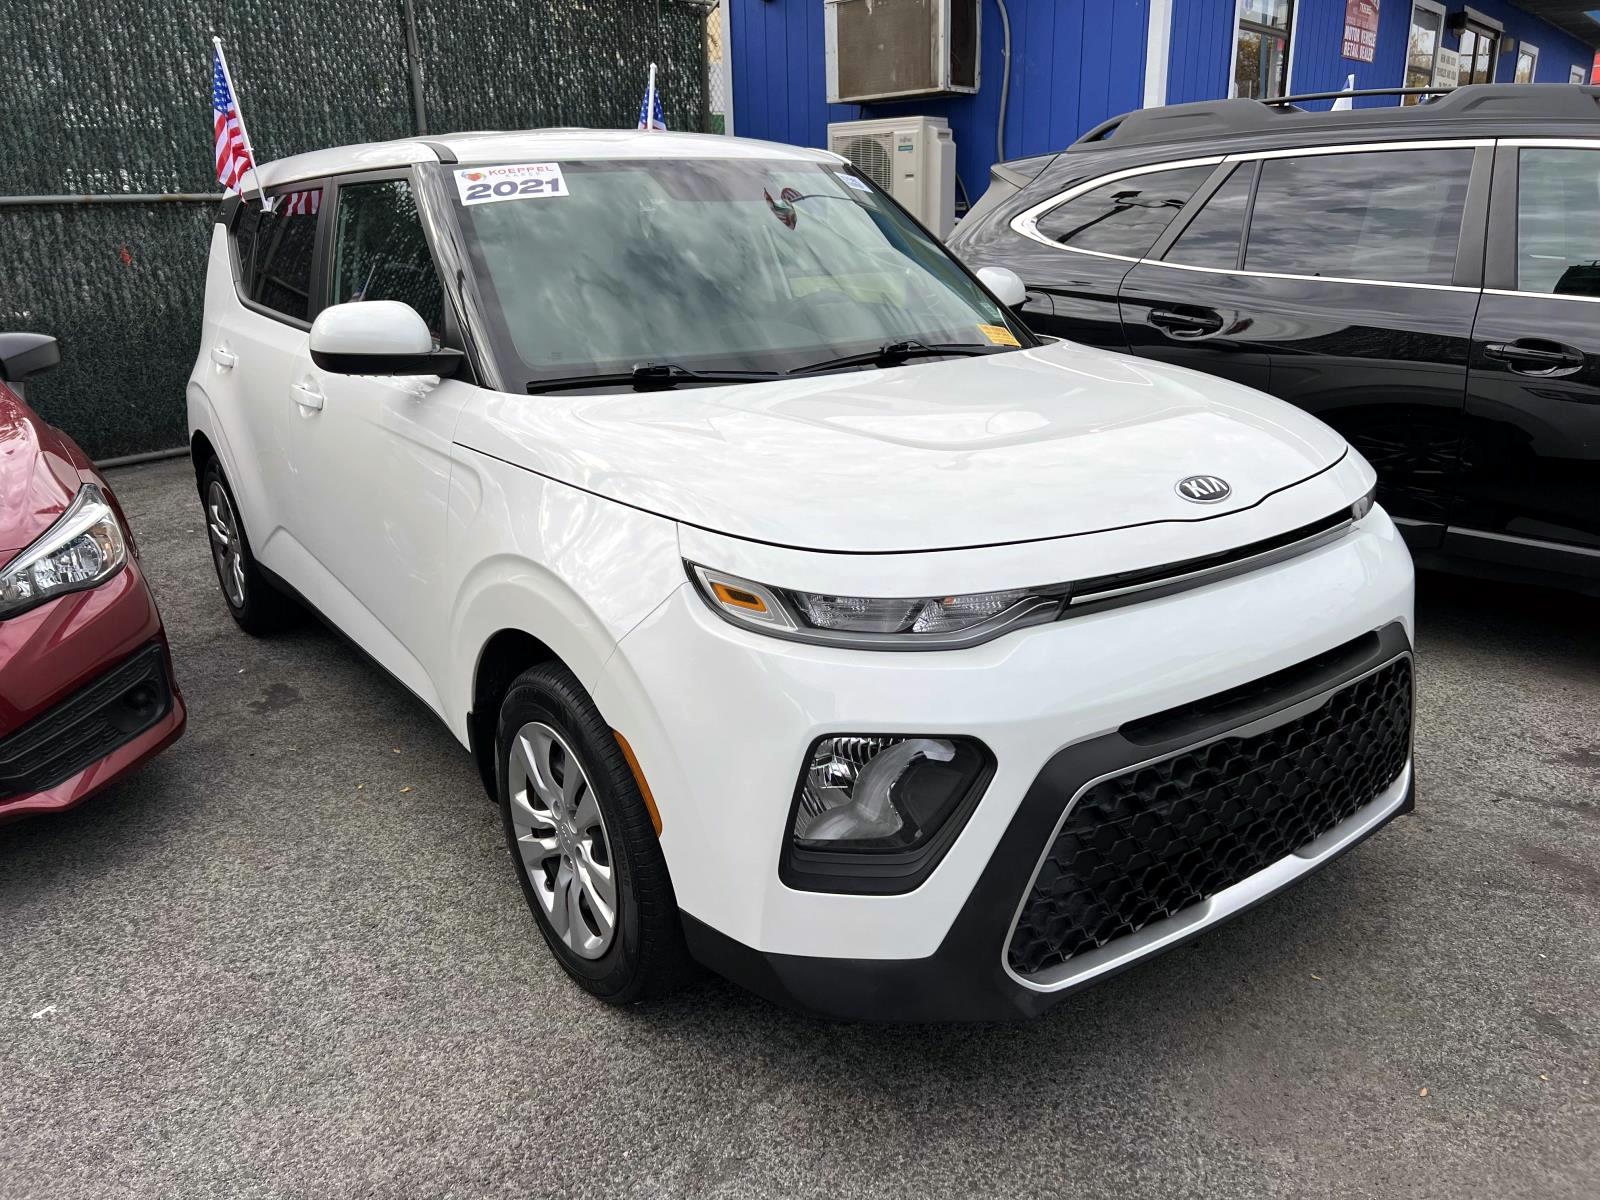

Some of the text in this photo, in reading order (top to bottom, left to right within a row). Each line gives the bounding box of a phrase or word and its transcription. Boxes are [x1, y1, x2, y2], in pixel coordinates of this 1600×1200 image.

[488, 166, 554, 176] KOEPPEL
[466, 178, 559, 200] 2021
[1182, 477, 1228, 497] KIA
